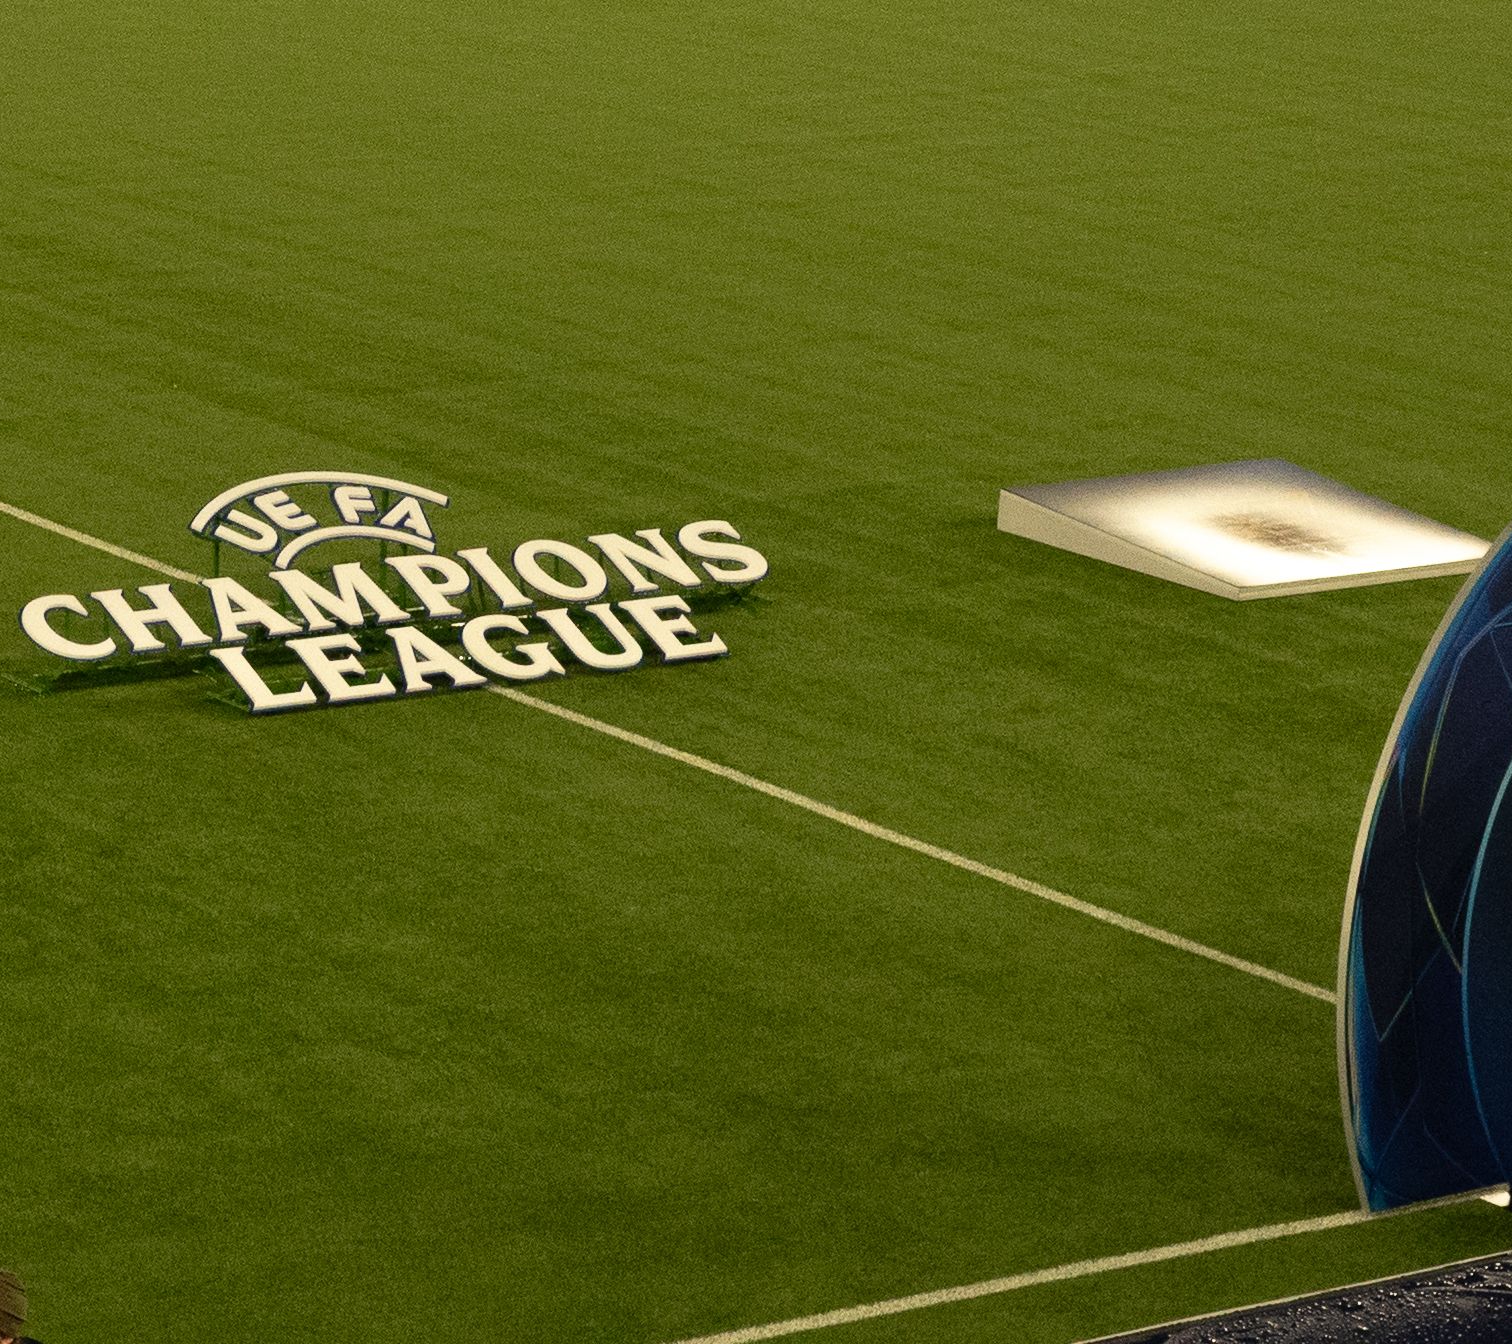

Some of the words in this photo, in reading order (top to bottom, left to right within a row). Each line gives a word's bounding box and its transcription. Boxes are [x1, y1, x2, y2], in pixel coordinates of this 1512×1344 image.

[213, 486, 436, 555] UEFA
[19, 519, 771, 662] CHAMPIONS
[209, 595, 729, 712] LEAGUE
